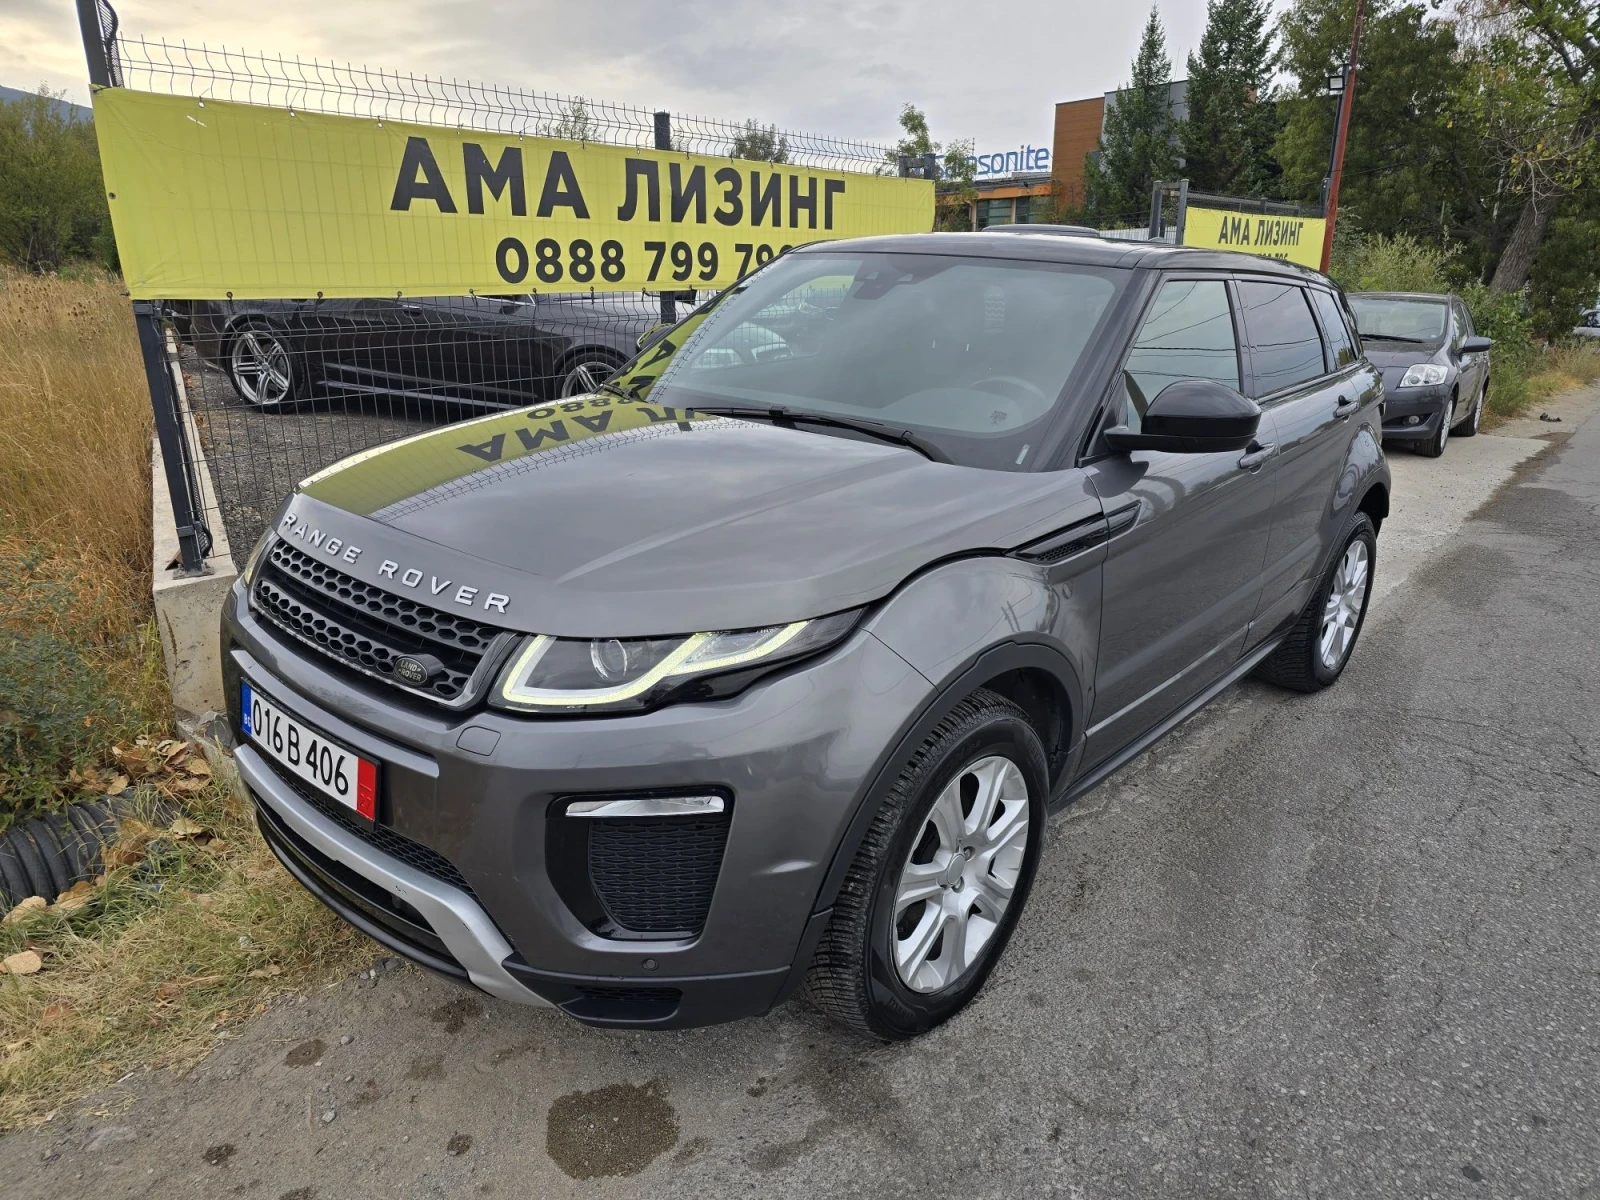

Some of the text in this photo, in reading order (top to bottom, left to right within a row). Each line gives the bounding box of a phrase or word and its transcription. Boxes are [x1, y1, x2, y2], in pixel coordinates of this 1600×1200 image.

[935, 144, 1050, 178] sonite
[390, 136, 846, 230] АМА ЛИЗИНГ
[1218, 216, 1303, 246] АМА ЛИЗИНГ
[495, 237, 626, 284] 0888
[644, 241, 719, 282] 799
[283, 512, 511, 614] RANGE ROVER
[400, 660, 418, 672] LAND
[401, 668, 421, 682] ROVER
